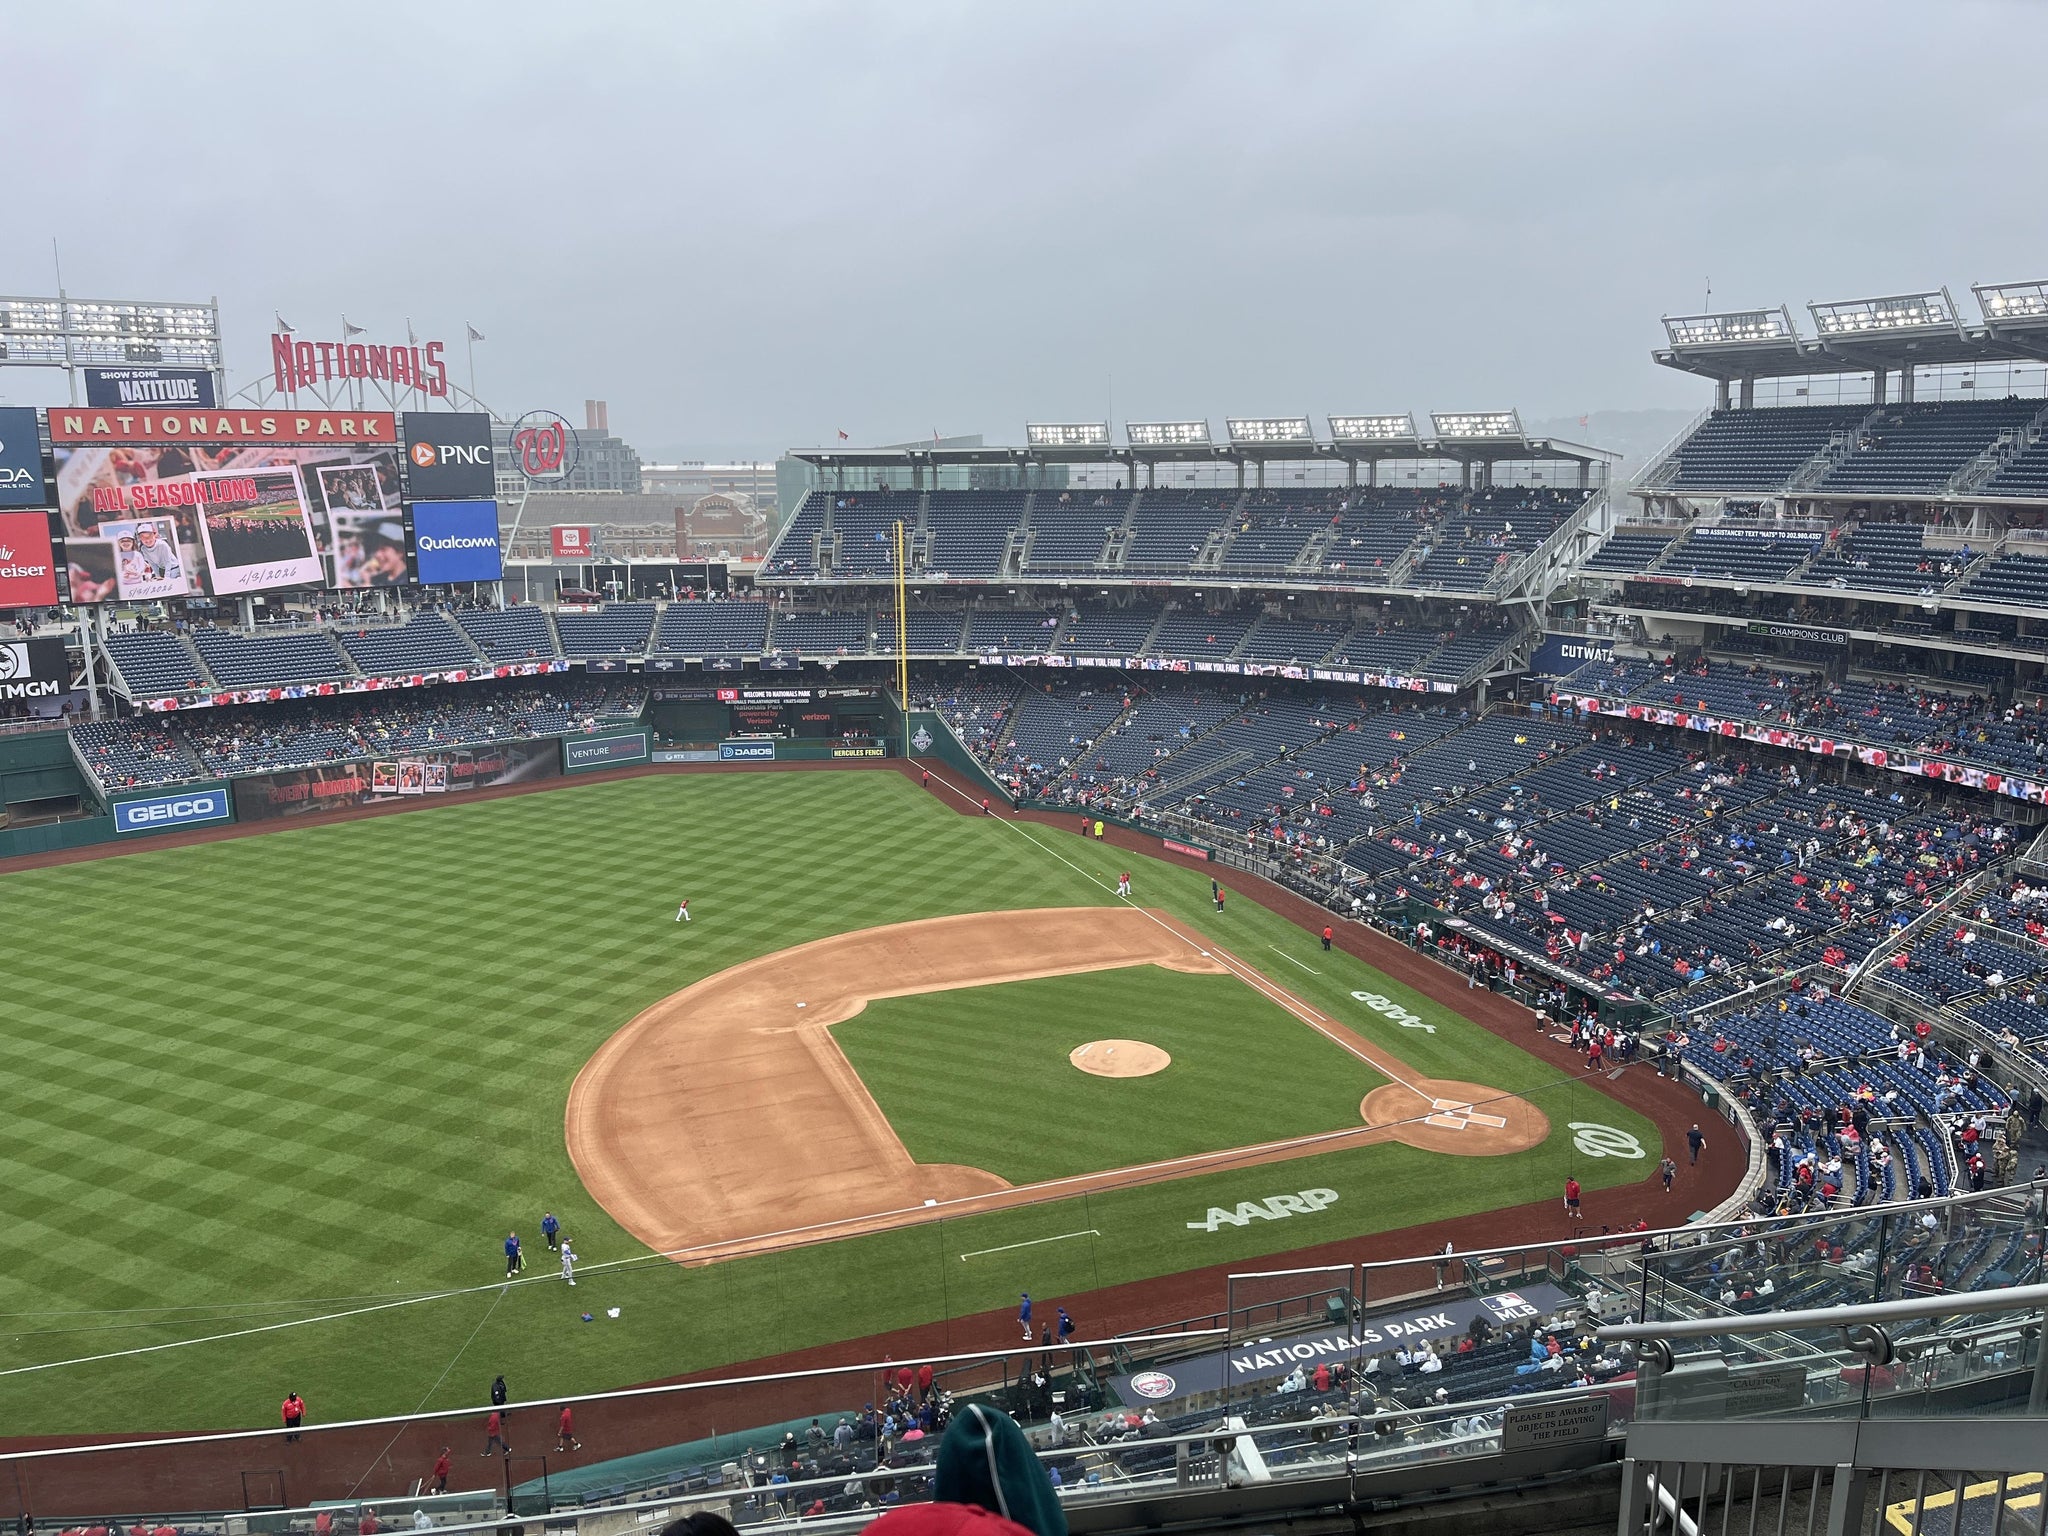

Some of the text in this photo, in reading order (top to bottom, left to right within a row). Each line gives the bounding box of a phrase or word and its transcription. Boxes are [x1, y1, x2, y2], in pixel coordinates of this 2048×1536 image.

[271, 334, 447, 397] NATIONALS
[100, 371, 159, 379] SHOW SOME
[118, 378, 199, 402] NATITUDE
[63, 416, 380, 436] NATIONALS PARK
[437, 445, 491, 465] PNC
[93, 478, 258, 512] ALL SEASON LONG
[1710, 529, 1745, 537] ASSISTANCE?
[419, 535, 497, 552] Qualcomm
[0, 563, 47, 578] eiser
[1749, 624, 1845, 643] FIS CHAMPIONS CLUB
[991, 656, 1003, 665] FANS
[1076, 657, 1121, 668] THANK YOU, FANS
[1194, 662, 1240, 673] THANK YOU, FANS
[1313, 670, 1360, 682] THANK YOU, FANS
[721, 690, 734, 699] 1:59
[1433, 681, 1450, 692] THANK
[738, 710, 779, 719] powered by
[801, 713, 831, 721] verizon
[571, 746, 610, 758] VENTURE
[734, 748, 773, 756] DABOS
[833, 749, 864, 757] HERCULES
[127, 797, 215, 824] GEICO
[1464, 926, 1607, 993] WASHINGTON NATIONALS
[1350, 991, 1437, 1034] AARP
[1187, 1187, 1339, 1232] AARP
[1493, 1304, 1539, 1322] MLB
[1230, 1312, 1456, 1373] NATIONALS PARK
[1510, 1404, 1604, 1424] PLEASE BE AWARE OF
[1517, 1415, 1596, 1432] OBJECTS LEAVING
[1533, 1427, 1580, 1440] THE FIELD
